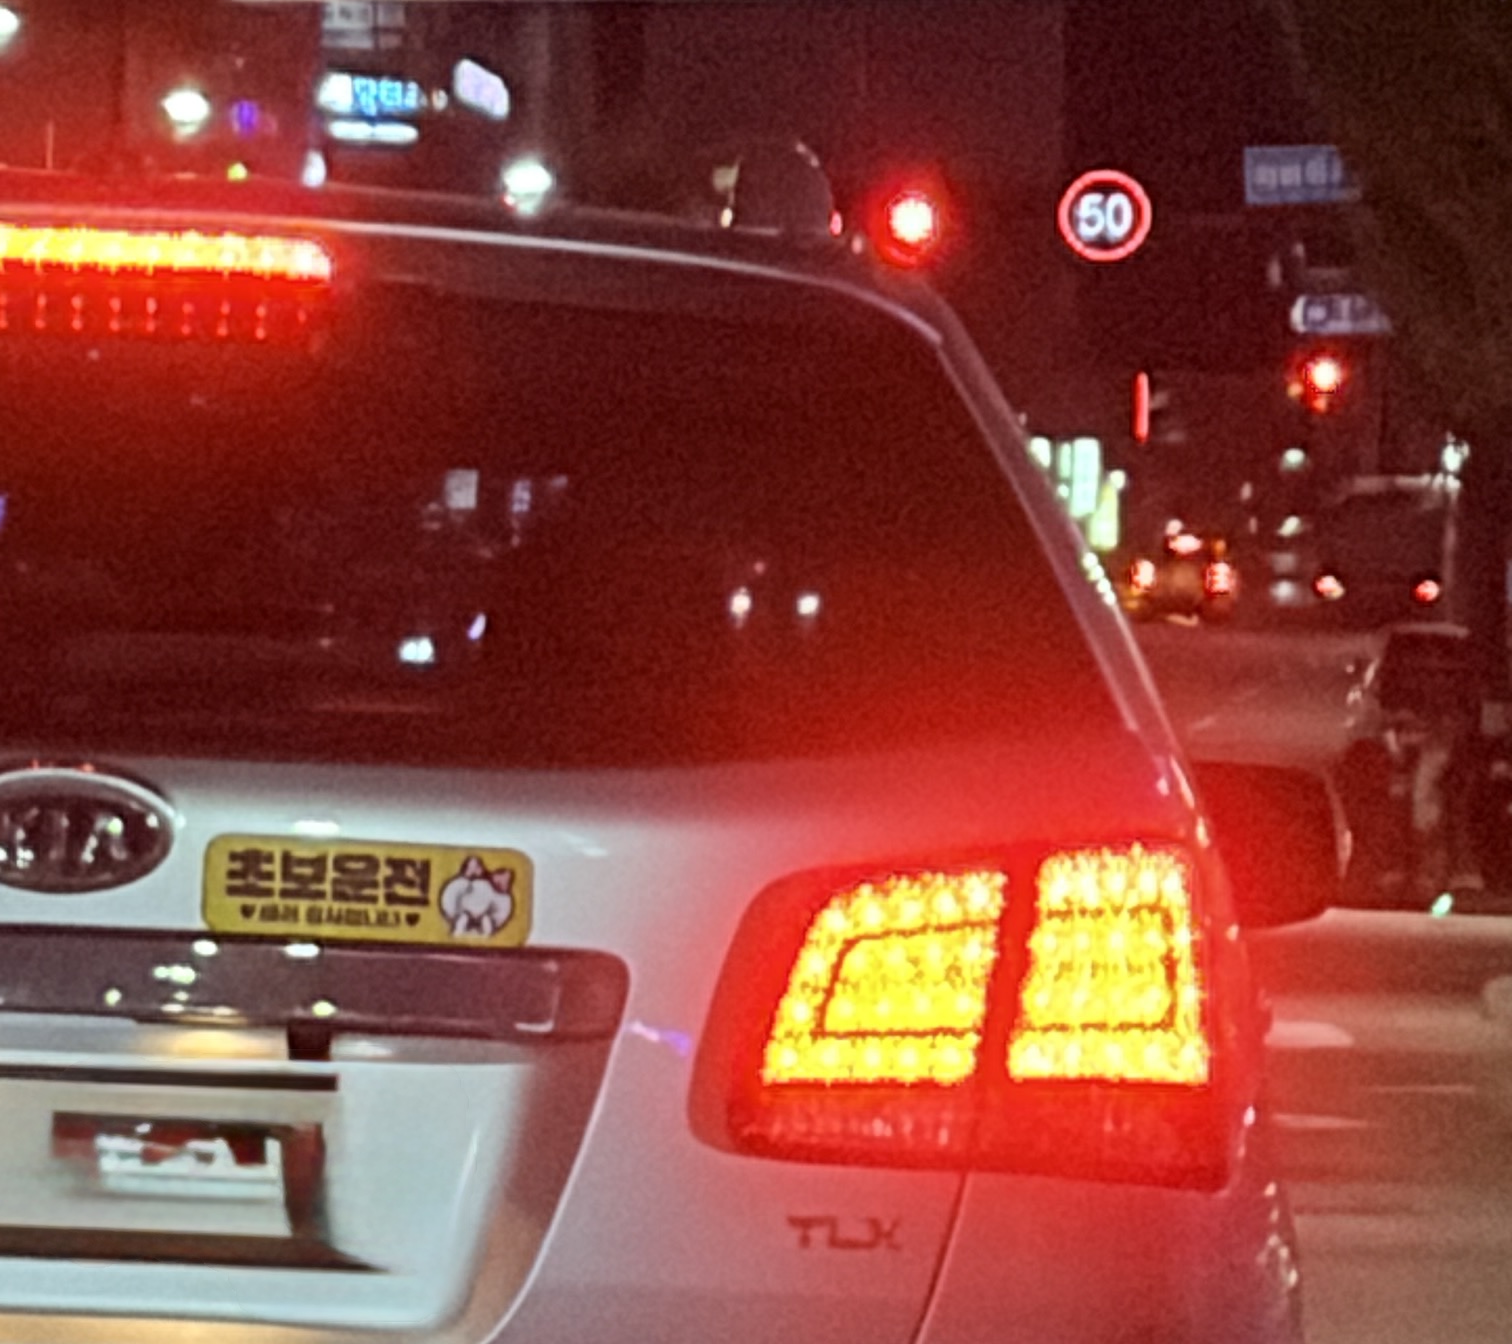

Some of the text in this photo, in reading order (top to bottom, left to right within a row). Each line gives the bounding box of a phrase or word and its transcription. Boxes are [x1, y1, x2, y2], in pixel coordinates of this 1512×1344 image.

[1077, 191, 1133, 243] 50
[225, 848, 431, 907] 초보운전
[787, 1215, 902, 1250] TLX
